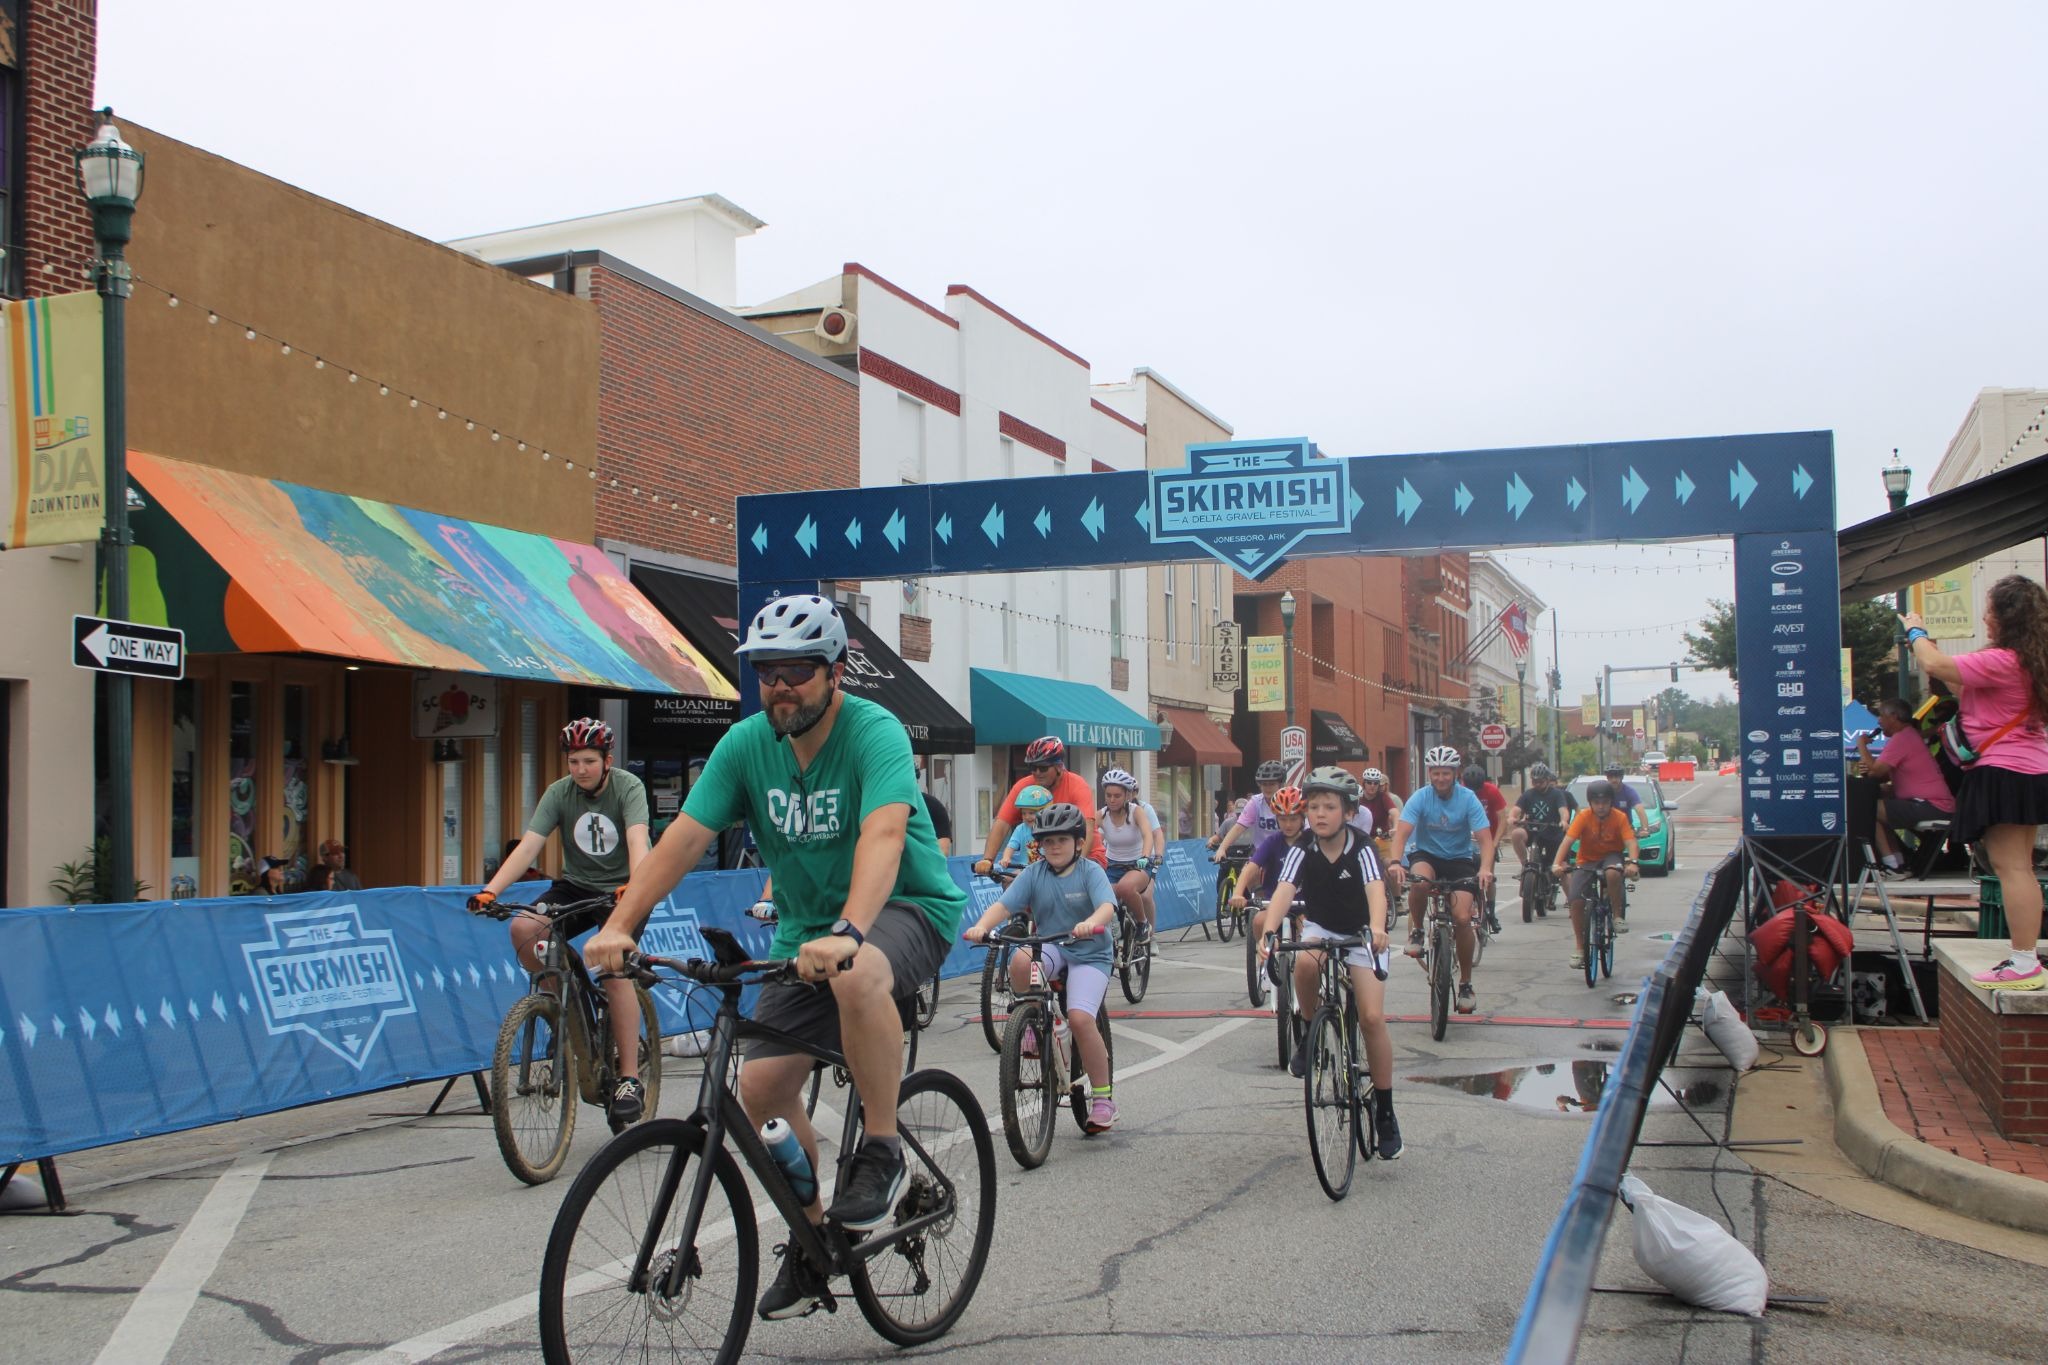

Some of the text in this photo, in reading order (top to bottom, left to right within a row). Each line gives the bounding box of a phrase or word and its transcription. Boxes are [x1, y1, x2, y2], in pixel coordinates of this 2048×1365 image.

[1233, 456, 1261, 468] THE
[33, 447, 99, 494] DJA
[1167, 478, 1331, 514] SKIRMISH
[31, 493, 100, 514] DOWNTOWN
[1181, 509, 1316, 524] A DELTA GRAVEL FESTIVAL
[1268, 533, 1286, 541] ARK
[1924, 595, 1966, 616] DJA
[1925, 616, 1968, 625] DOWNTOWN
[1772, 624, 1805, 636] ARVEST
[109, 638, 174, 662] ONE WAY
[1220, 628, 1233, 672] STAGE
[1250, 660, 1282, 670] SHOP
[1254, 676, 1279, 686] LIVE
[654, 699, 733, 710] McDANIEL
[1066, 722, 1145, 748] THE ARTS CENTER
[1285, 734, 1303, 748] USA
[1285, 748, 1304, 757] CYCLING
[309, 927, 332, 941] THE
[640, 926, 698, 953] IRMISH
[265, 952, 393, 998] SKIRMISH
